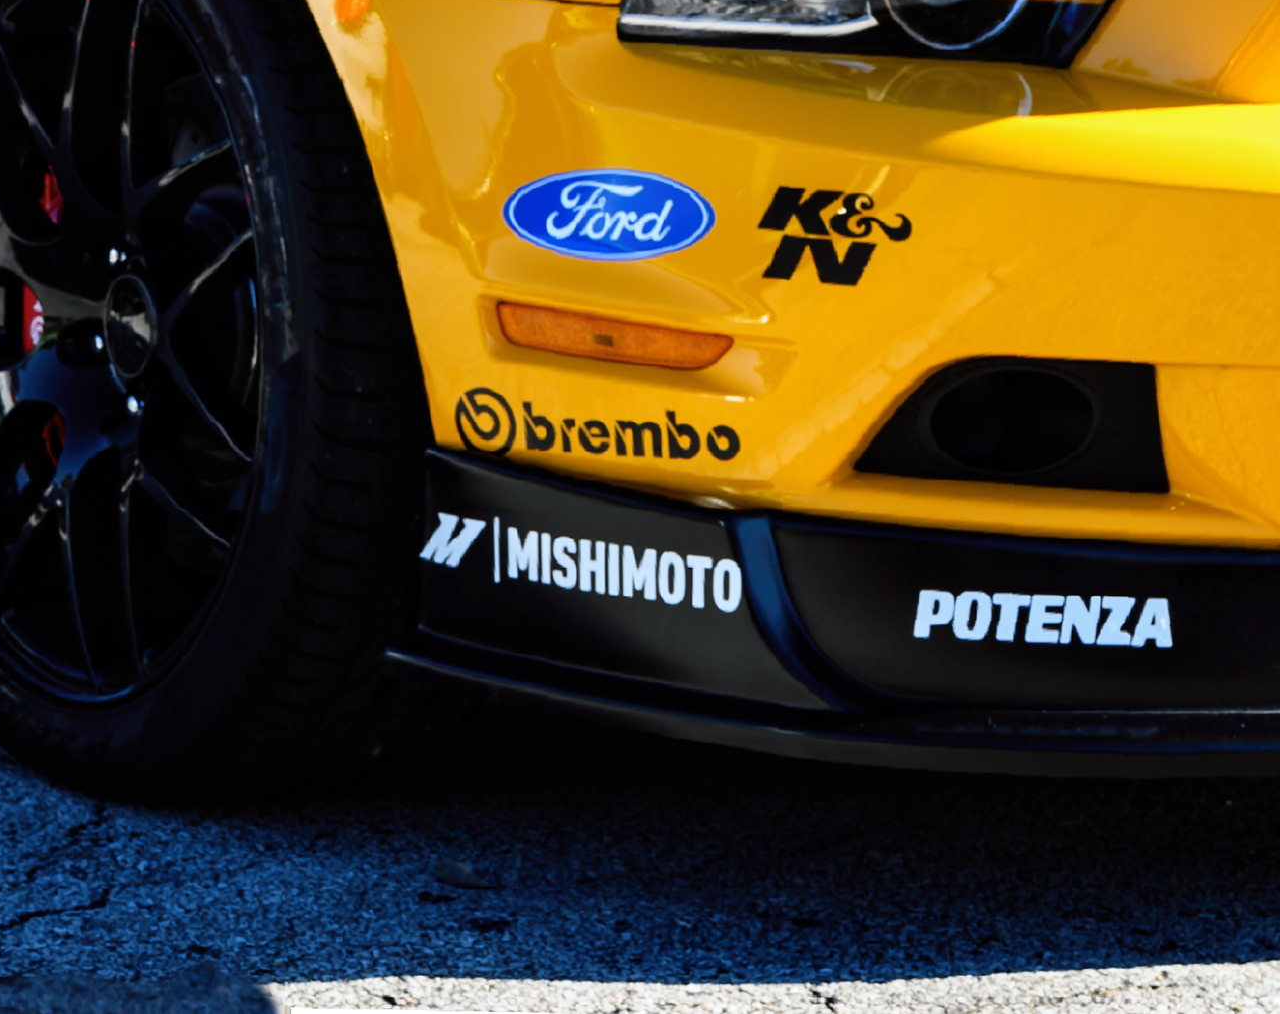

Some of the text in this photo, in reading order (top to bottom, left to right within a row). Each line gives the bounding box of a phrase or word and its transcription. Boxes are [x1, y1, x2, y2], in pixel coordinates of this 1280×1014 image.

[545, 179, 673, 242] Ford
[522, 401, 741, 461] brembo
[507, 526, 743, 614] MISHIMOTO
[913, 588, 1173, 648] POTENZA
